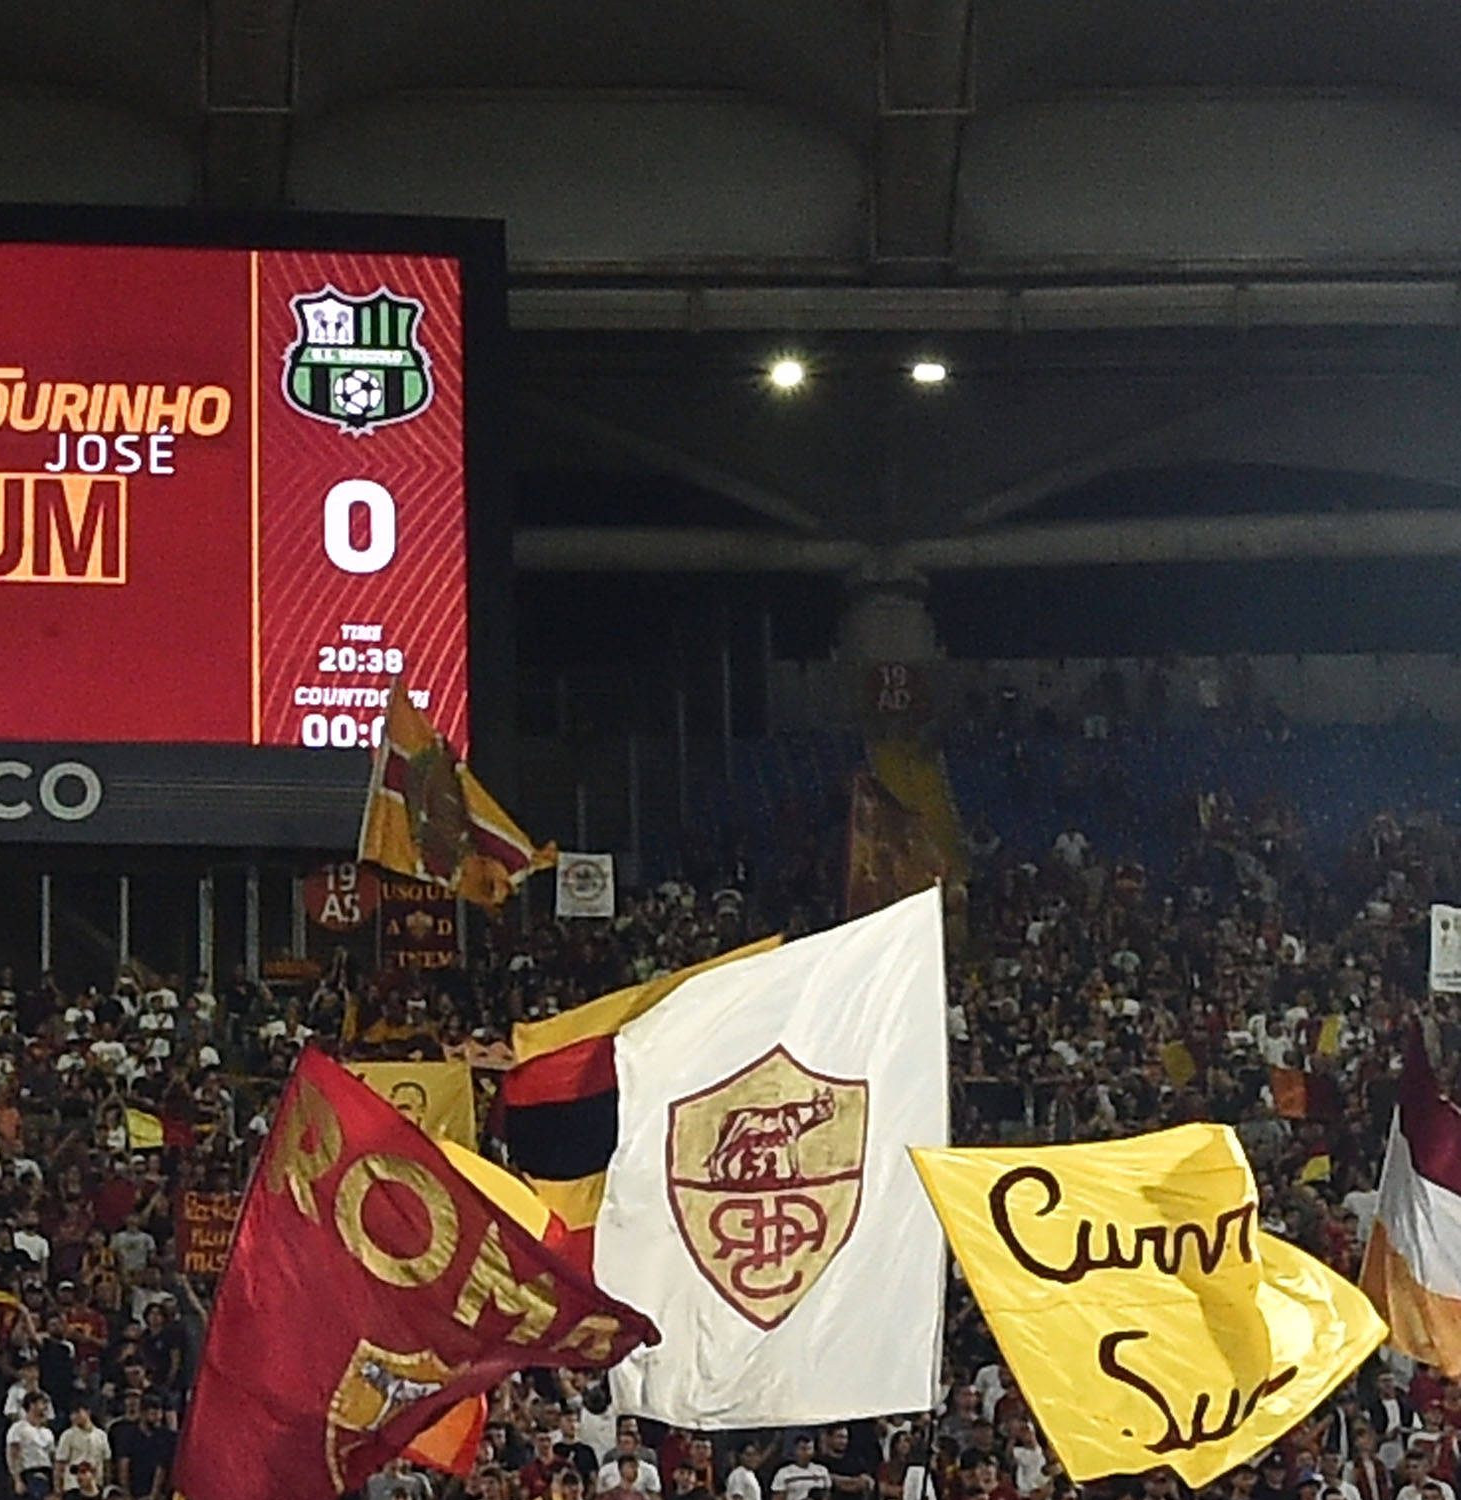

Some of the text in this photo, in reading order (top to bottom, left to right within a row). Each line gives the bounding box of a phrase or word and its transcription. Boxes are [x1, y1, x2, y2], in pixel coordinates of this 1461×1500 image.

[44, 426, 176, 475] JOSÉ
[323, 478, 398, 574] 0
[318, 646, 404, 674] 20:38
[323, 863, 357, 892] 19
[320, 893, 361, 923] AS
